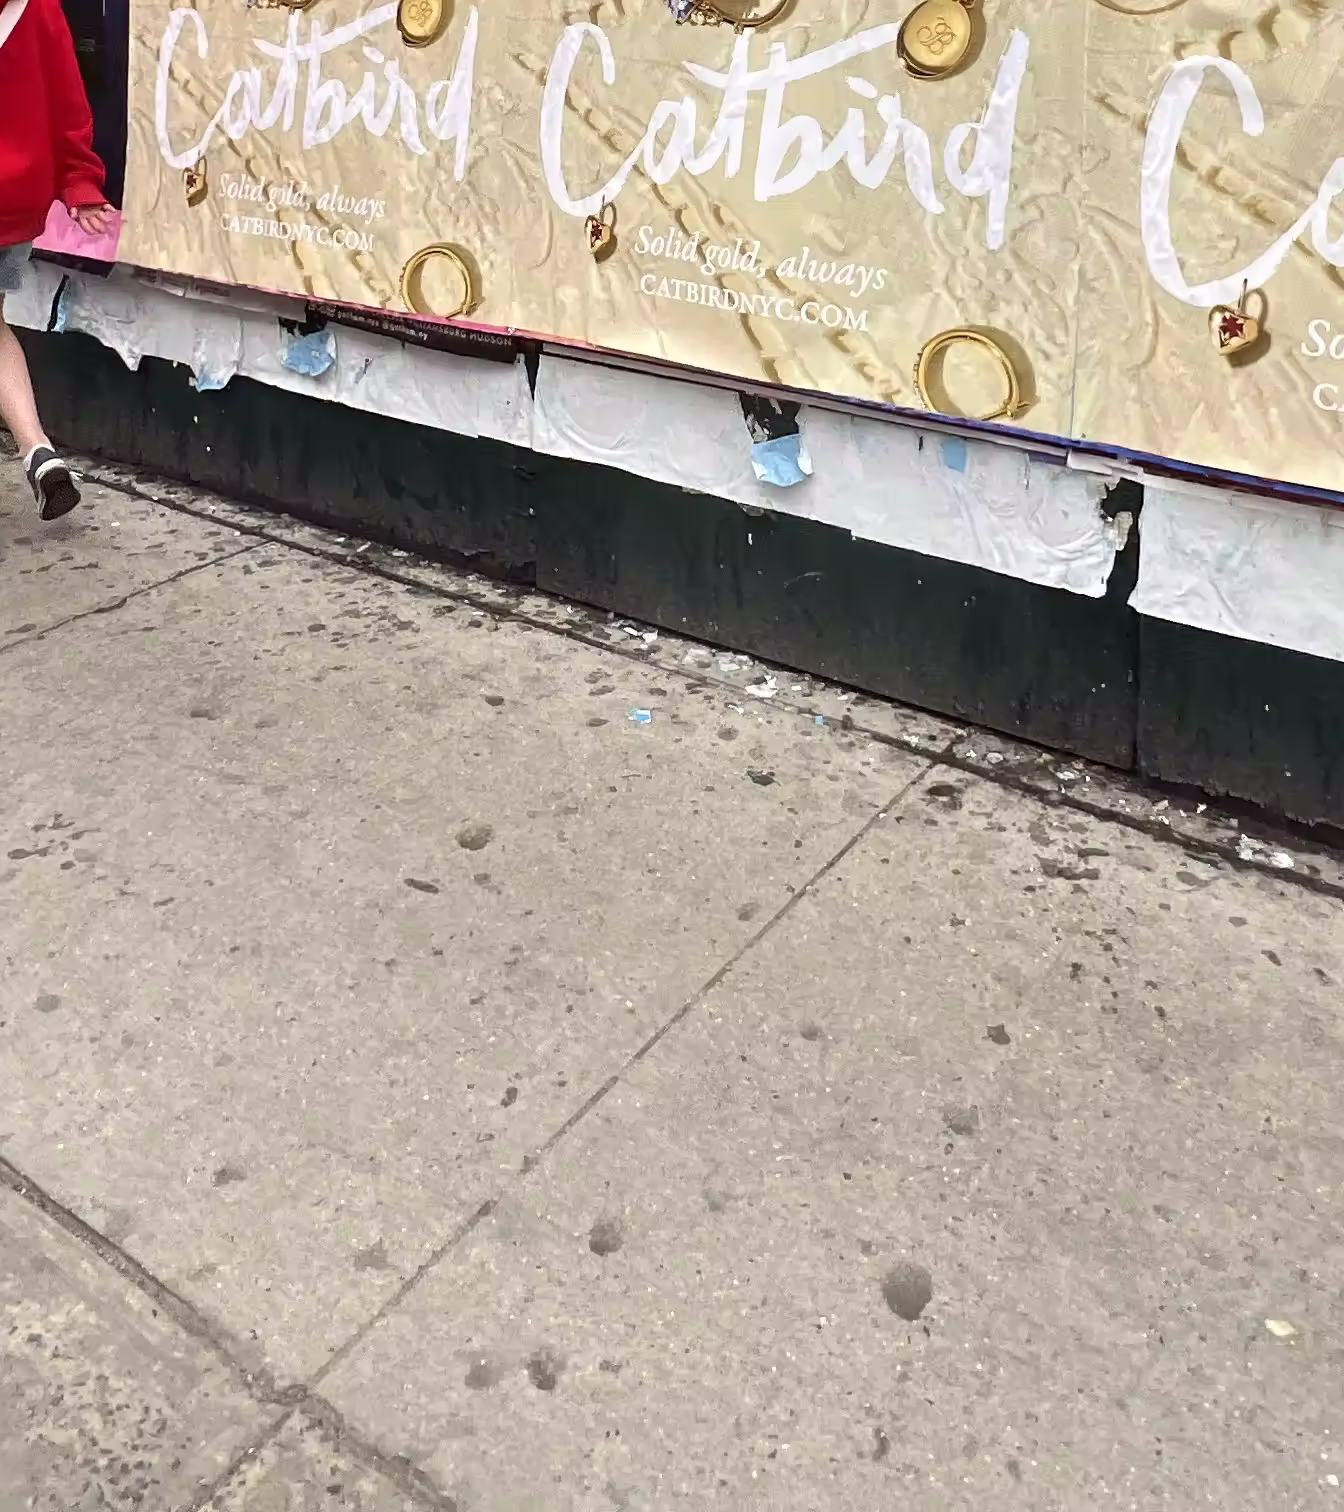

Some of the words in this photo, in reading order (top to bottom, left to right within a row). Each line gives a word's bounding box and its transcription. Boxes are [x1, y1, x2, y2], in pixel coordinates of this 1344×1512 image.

[155, 1, 479, 182] Catbird
[540, 21, 1031, 251] Catbird
[219, 172, 265, 202] Solid
[317, 185, 387, 225] always
[220, 214, 375, 252] CATBIRDNYC.COM
[634, 225, 701, 263] Solid
[699, 237, 766, 279] gold,
[775, 247, 889, 299] always
[640, 273, 870, 332] CATBIRDNYC.COM
[469, 332, 513, 347] HUDSON
